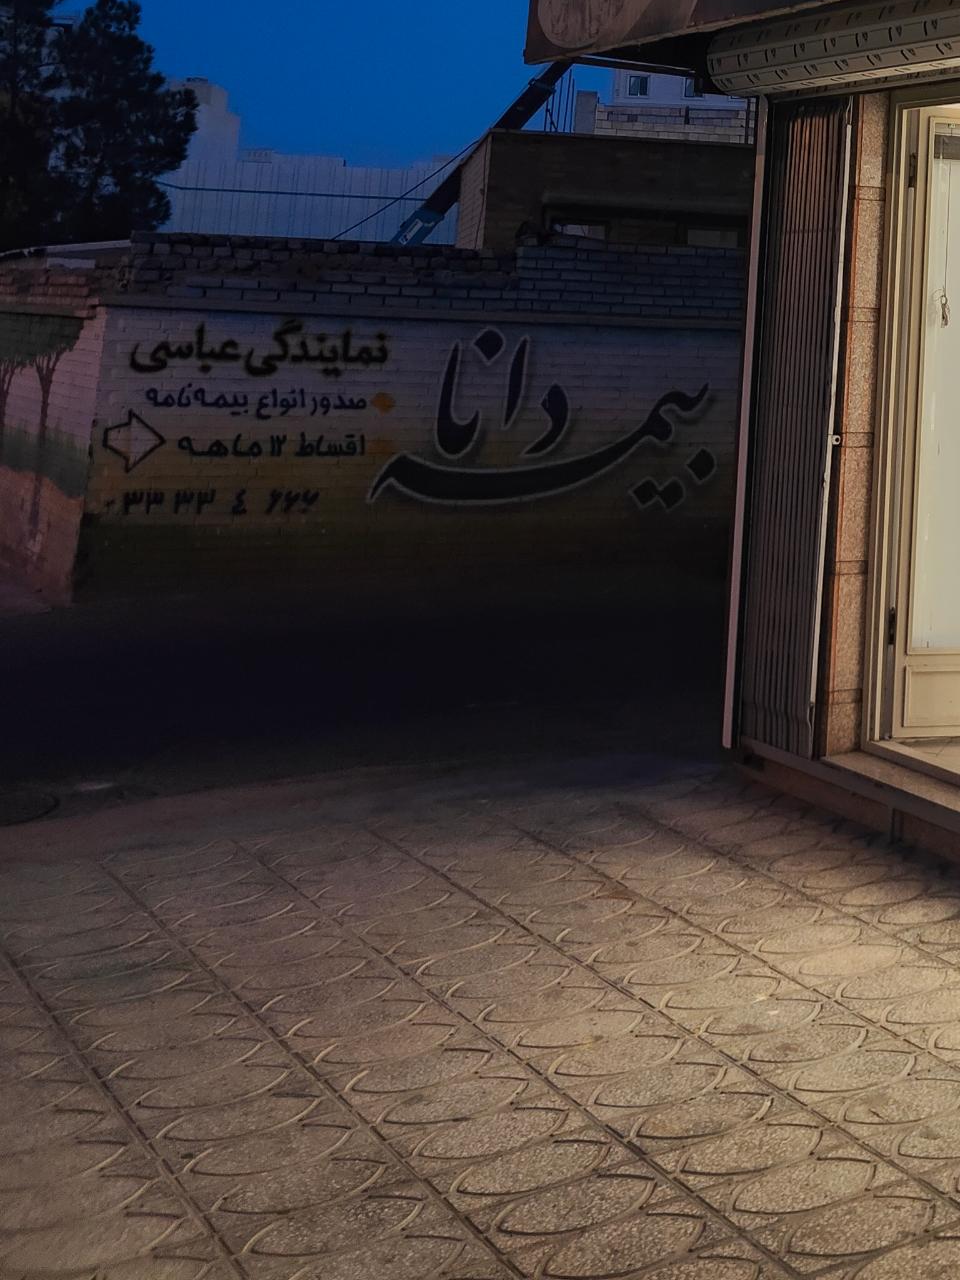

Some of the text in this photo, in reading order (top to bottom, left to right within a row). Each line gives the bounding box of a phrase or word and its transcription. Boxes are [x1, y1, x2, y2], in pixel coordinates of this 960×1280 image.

[129, 319, 388, 377] نمایندگی عباسی
[256, 388, 305, 419] انواع
[311, 389, 366, 414] صدور
[432, 326, 571, 459] دانا
[178, 433, 262, 457] ماهه
[296, 435, 364, 457] اقساط
